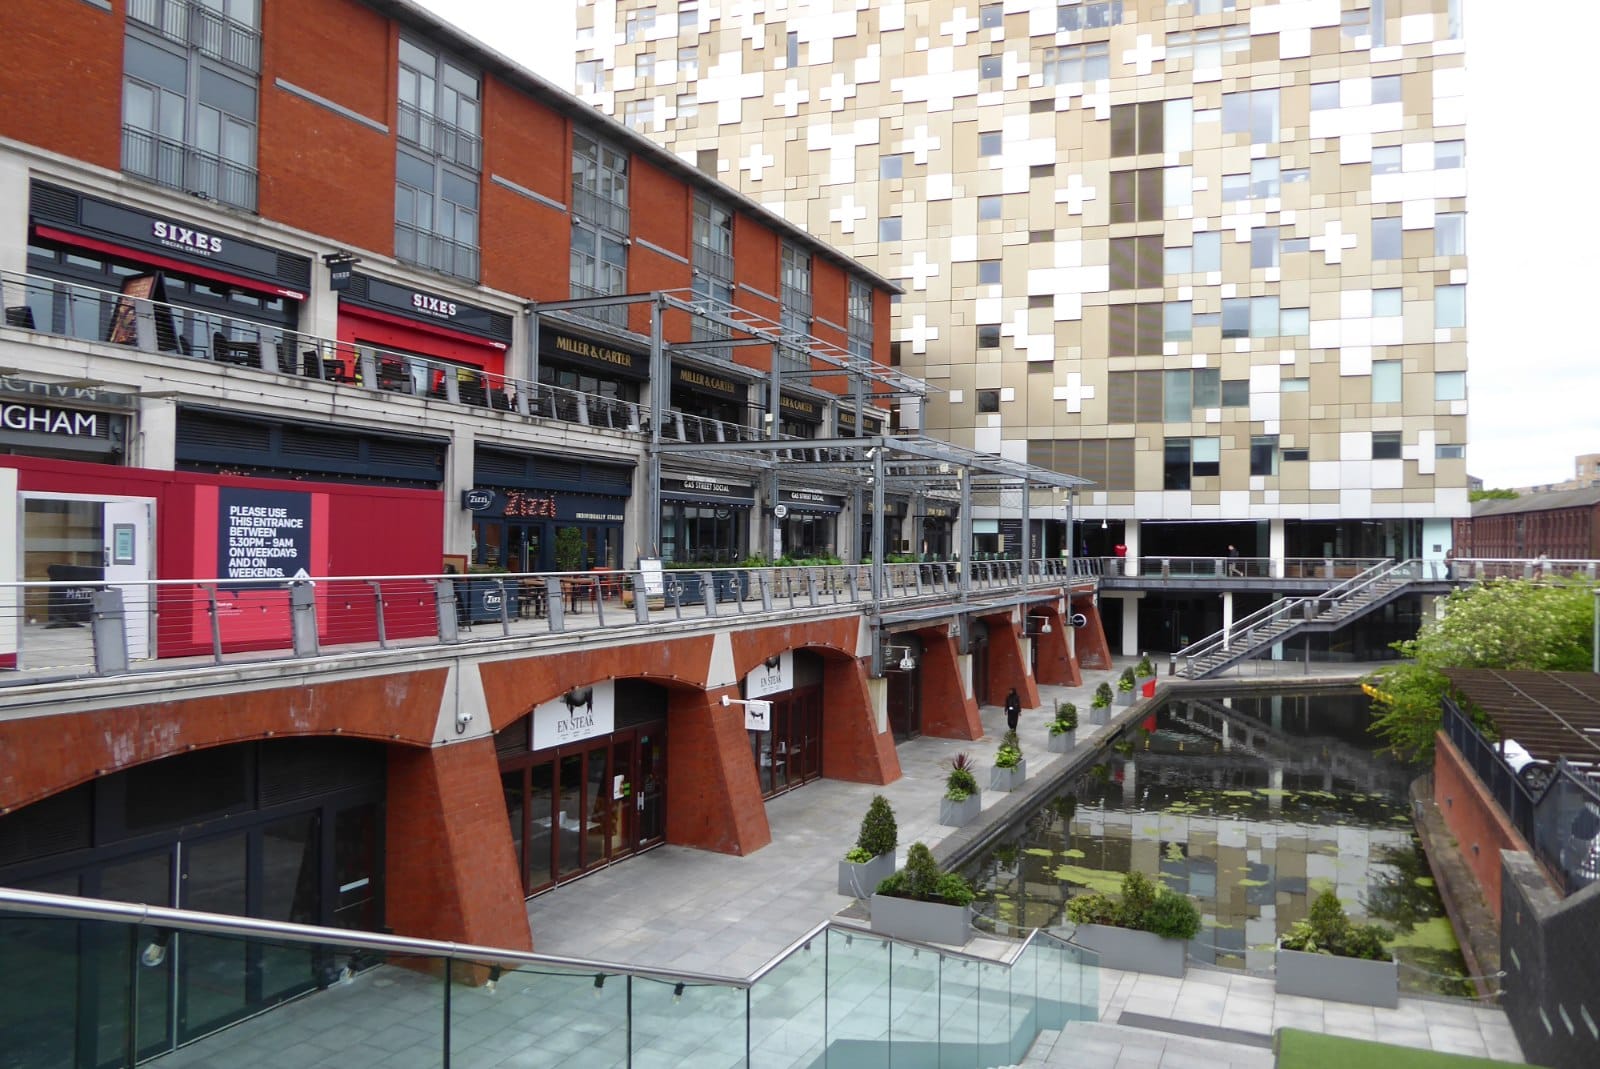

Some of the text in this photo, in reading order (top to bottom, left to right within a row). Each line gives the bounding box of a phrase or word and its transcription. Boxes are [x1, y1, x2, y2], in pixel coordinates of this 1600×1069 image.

[154, 221, 222, 253] SIXES
[413, 293, 457, 316] SIXES
[556, 336, 632, 367] MILLER & CARTER
[680, 369, 705, 386] MILLER
[0, 403, 97, 437] GHAM
[683, 480, 695, 489] GAS
[470, 495, 488, 503] Zizzi
[504, 490, 556, 517] Zizzi
[229, 505, 288, 518] PLEASE USE
[229, 516, 304, 529] THIS ENTRANCE
[229, 526, 277, 537] BETWEEN
[229, 537, 264, 547] 5.30PM
[272, 538, 294, 548] 9AM
[228, 547, 298, 558] ON WEEKDAYS
[228, 557, 267, 567] AND ON
[228, 567, 285, 578] WEEKENDS.
[557, 714, 594, 733] EN STEAK
